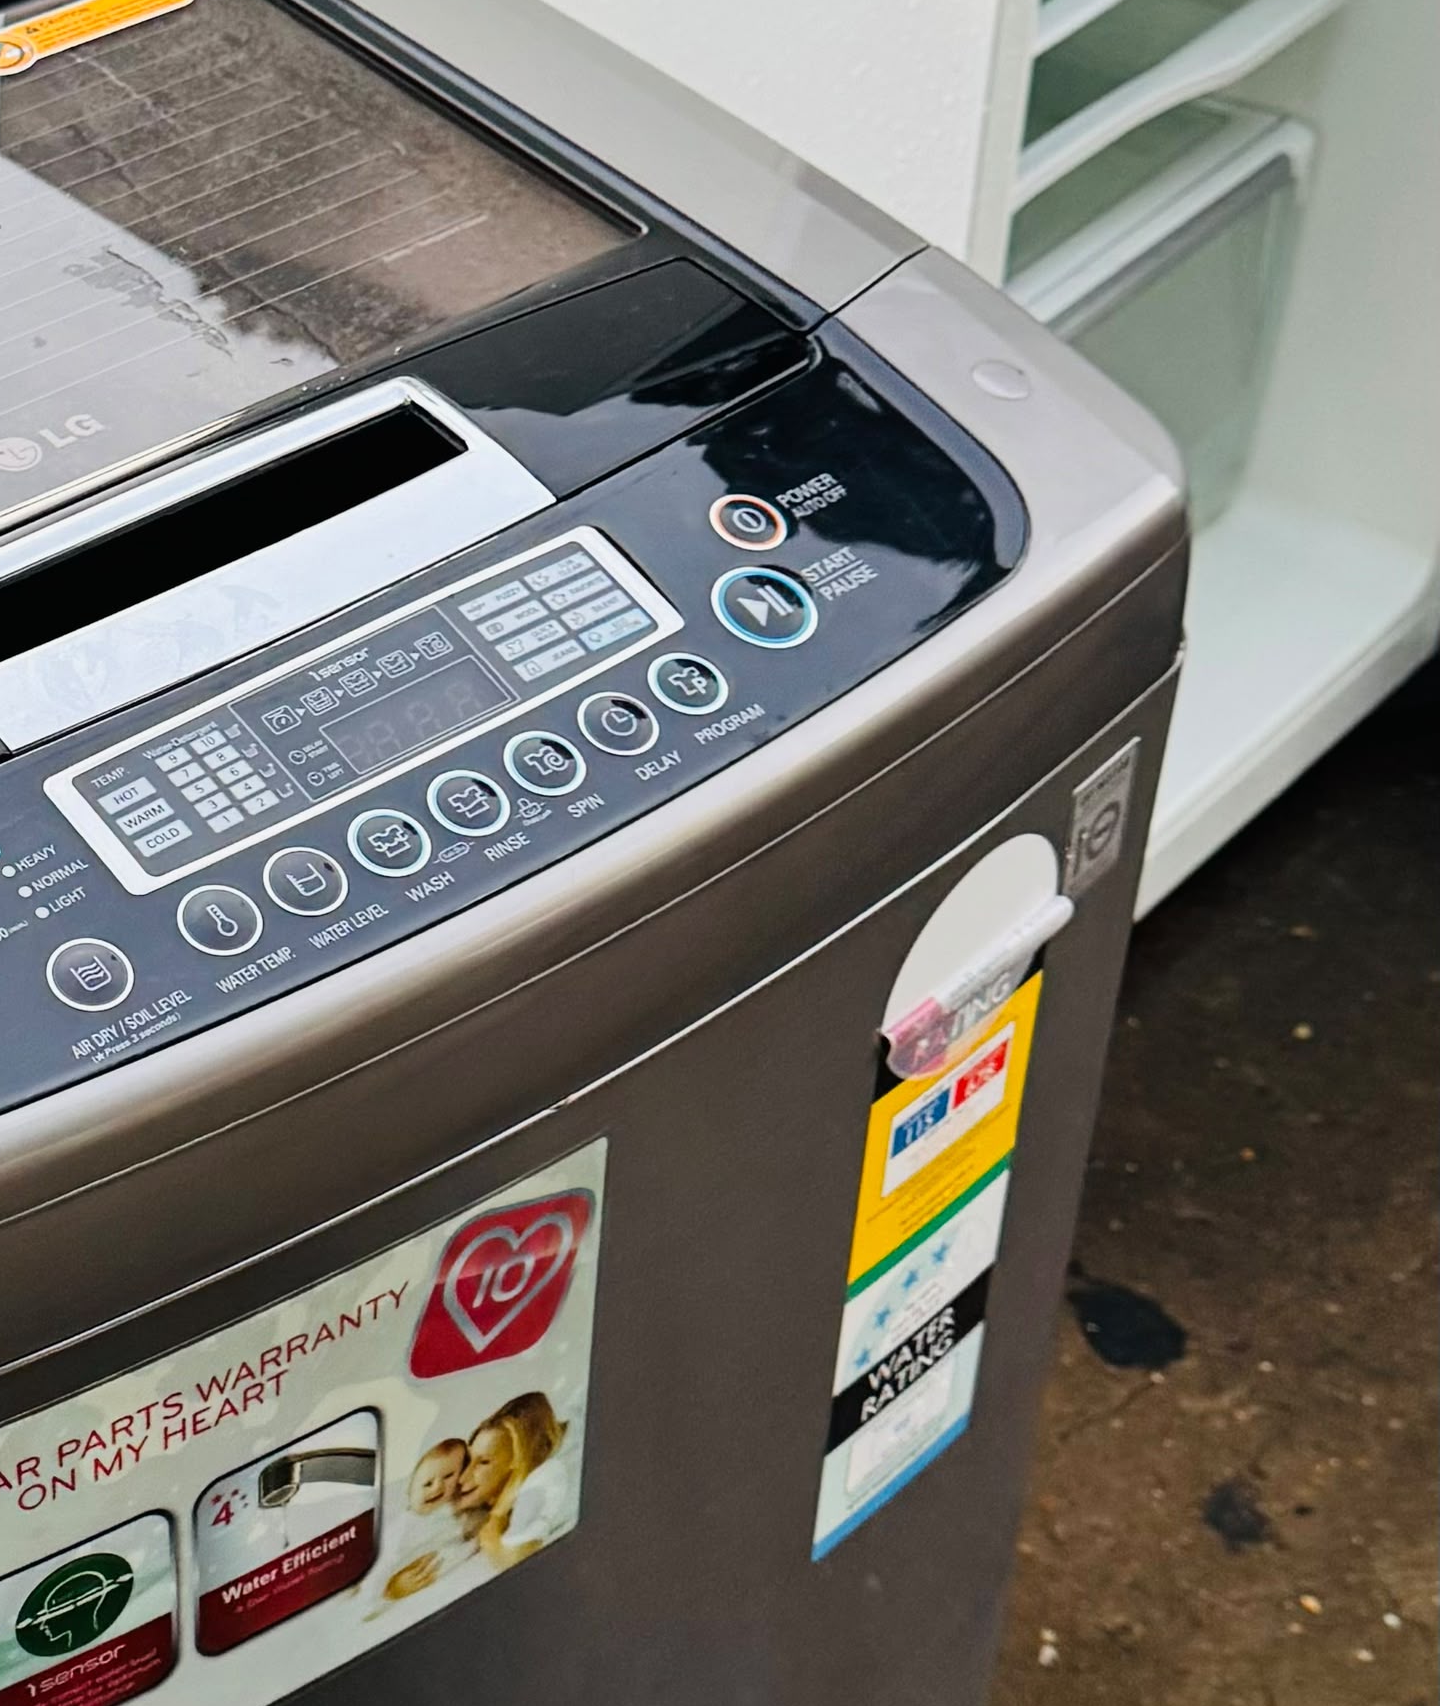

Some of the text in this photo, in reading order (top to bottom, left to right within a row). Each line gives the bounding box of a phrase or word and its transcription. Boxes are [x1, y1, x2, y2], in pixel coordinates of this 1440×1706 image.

[38, 414, 105, 449] LG
[775, 472, 839, 509] POWER
[802, 546, 858, 582] START
[818, 563, 878, 601] PAUSE
[694, 703, 766, 745] PROGRAM
[201, 736, 216, 748] 10
[634, 750, 682, 782] DELAY
[113, 786, 140, 806] HOT
[567, 794, 605, 819] SPIN
[123, 804, 165, 830] WARM
[146, 827, 180, 850] COLD
[483, 832, 532, 862] RINSE
[14, 844, 57, 872] HEAVY
[31, 859, 89, 892] NORMAL
[48, 886, 88, 913] LIGHT
[404, 871, 456, 903] WASH
[308, 903, 390, 952] WATER LEVEL
[215, 945, 297, 994] WATER TEMP.
[71, 1037, 94, 1060] AIR
[92, 1023, 118, 1048] DRY
[125, 1007, 157, 1031] SOIL
[151, 989, 193, 1014] LEVEL
[472, 1252, 537, 1309] 10
[868, 1306, 956, 1390] WATER
[57, 1390, 185, 1468] PARTS
[194, 1280, 410, 1398] WARRANTY
[861, 1328, 954, 1424] RATING
[16, 1370, 290, 1513] ON MY HEART
[211, 1500, 235, 1527] 4
[221, 1567, 280, 1605] Water
[281, 1525, 357, 1576] Efficient
